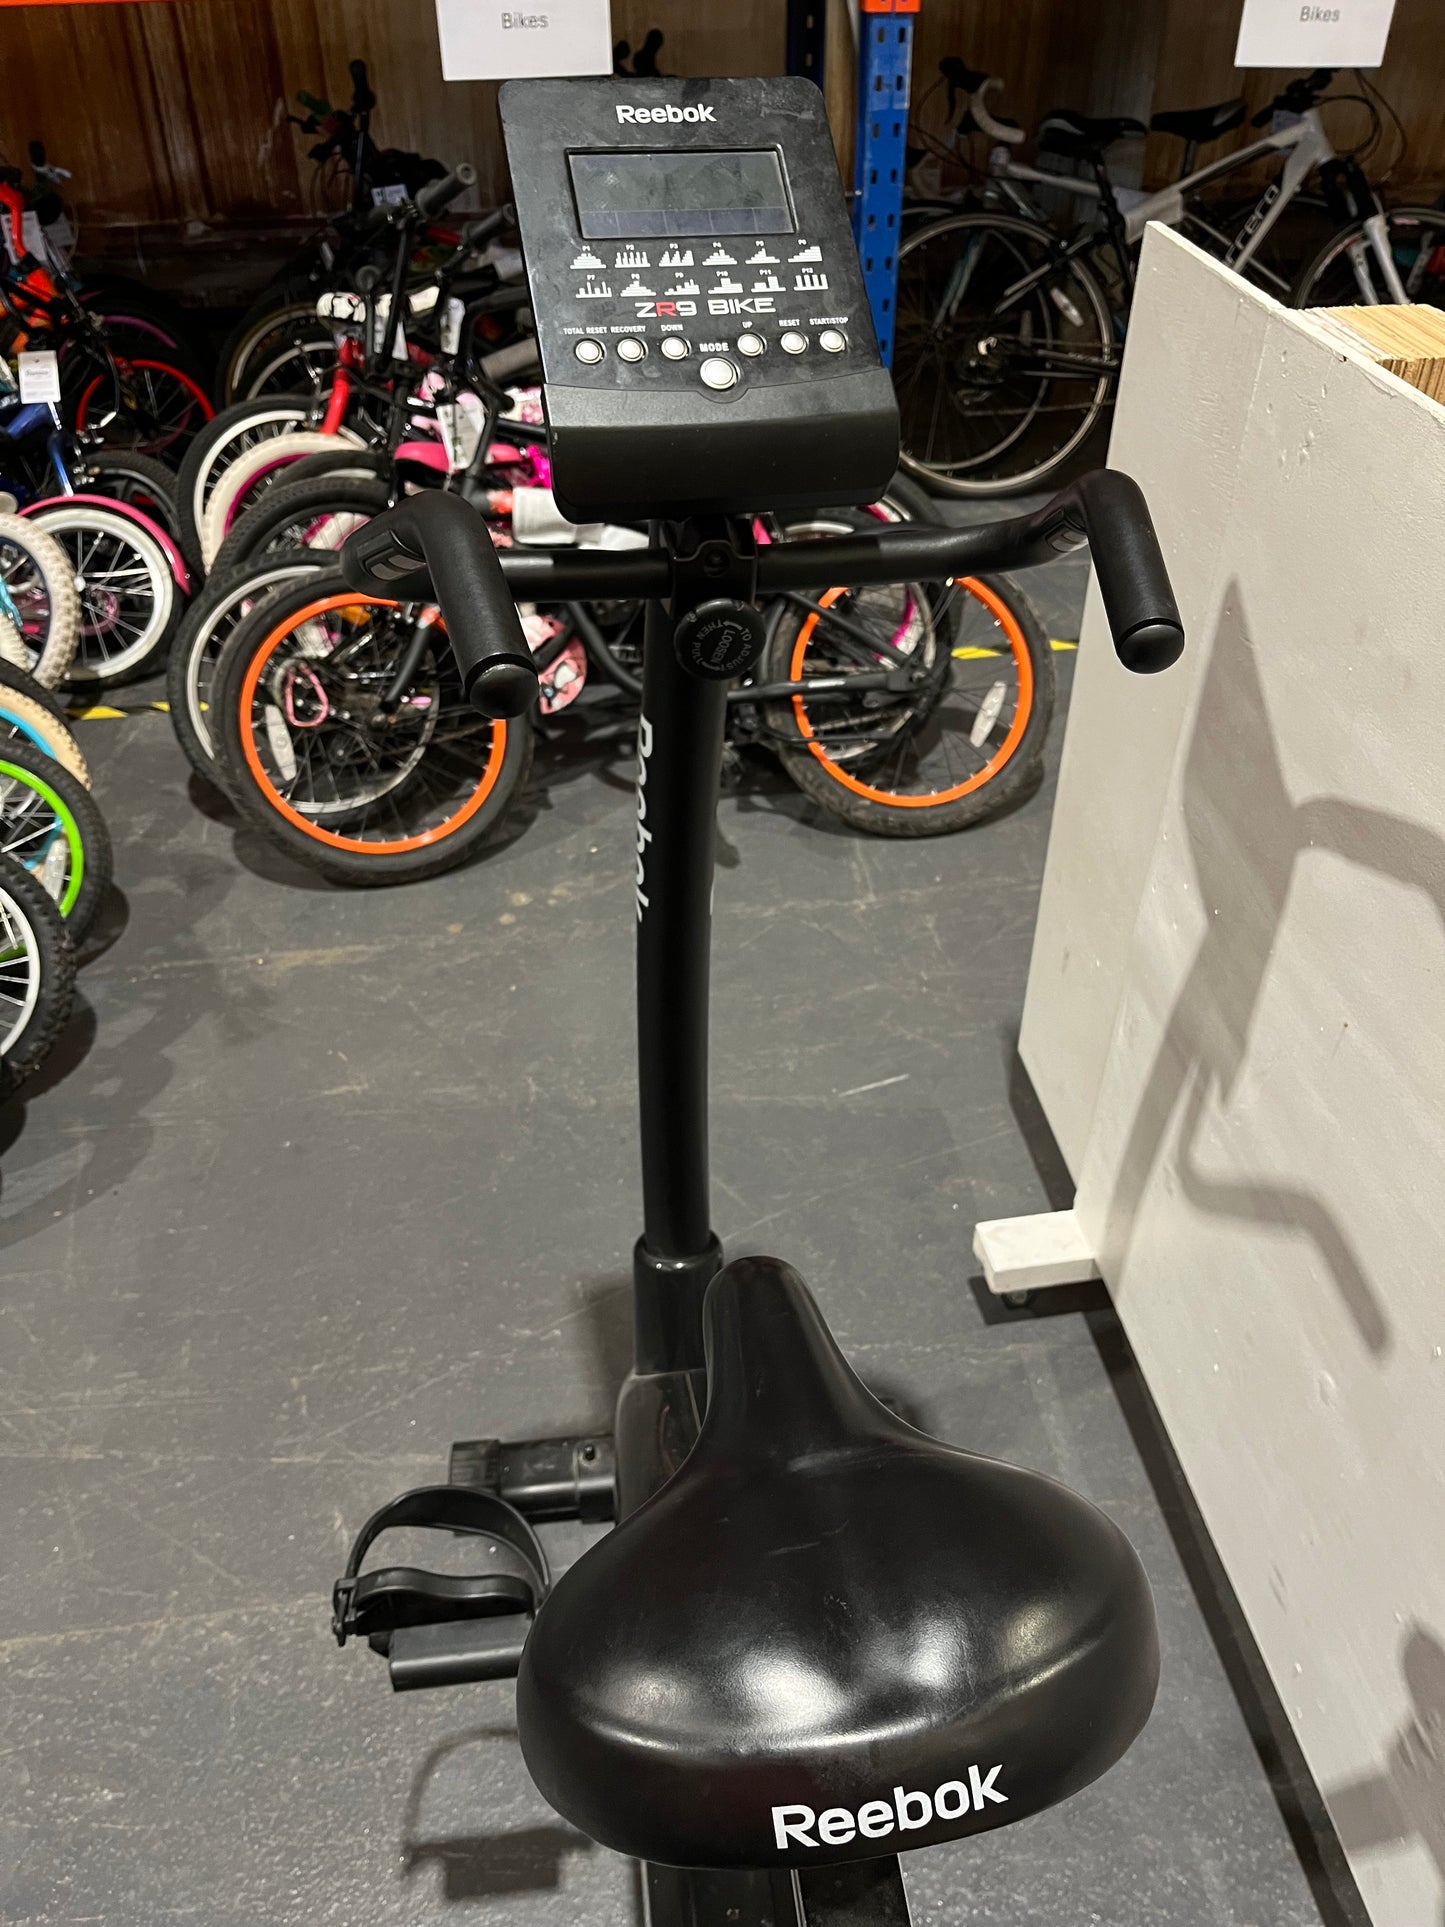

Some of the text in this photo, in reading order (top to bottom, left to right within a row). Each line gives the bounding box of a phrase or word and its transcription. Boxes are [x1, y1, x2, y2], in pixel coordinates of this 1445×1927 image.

[1299, 5, 1341, 22] Bikes
[501, 12, 549, 29] Bikes
[615, 103, 718, 124] Reebok
[634, 297, 776, 318] ZR9 BIKE
[778, 319, 800, 327] RESET
[809, 317, 849, 326] START/STOP
[563, 326, 608, 335] TOTAL RESET
[610, 325, 646, 333] RECOVERY
[660, 324, 684, 332] DOWN
[699, 342, 730, 352] MODE
[771, 1764, 1010, 1849] Reebok
